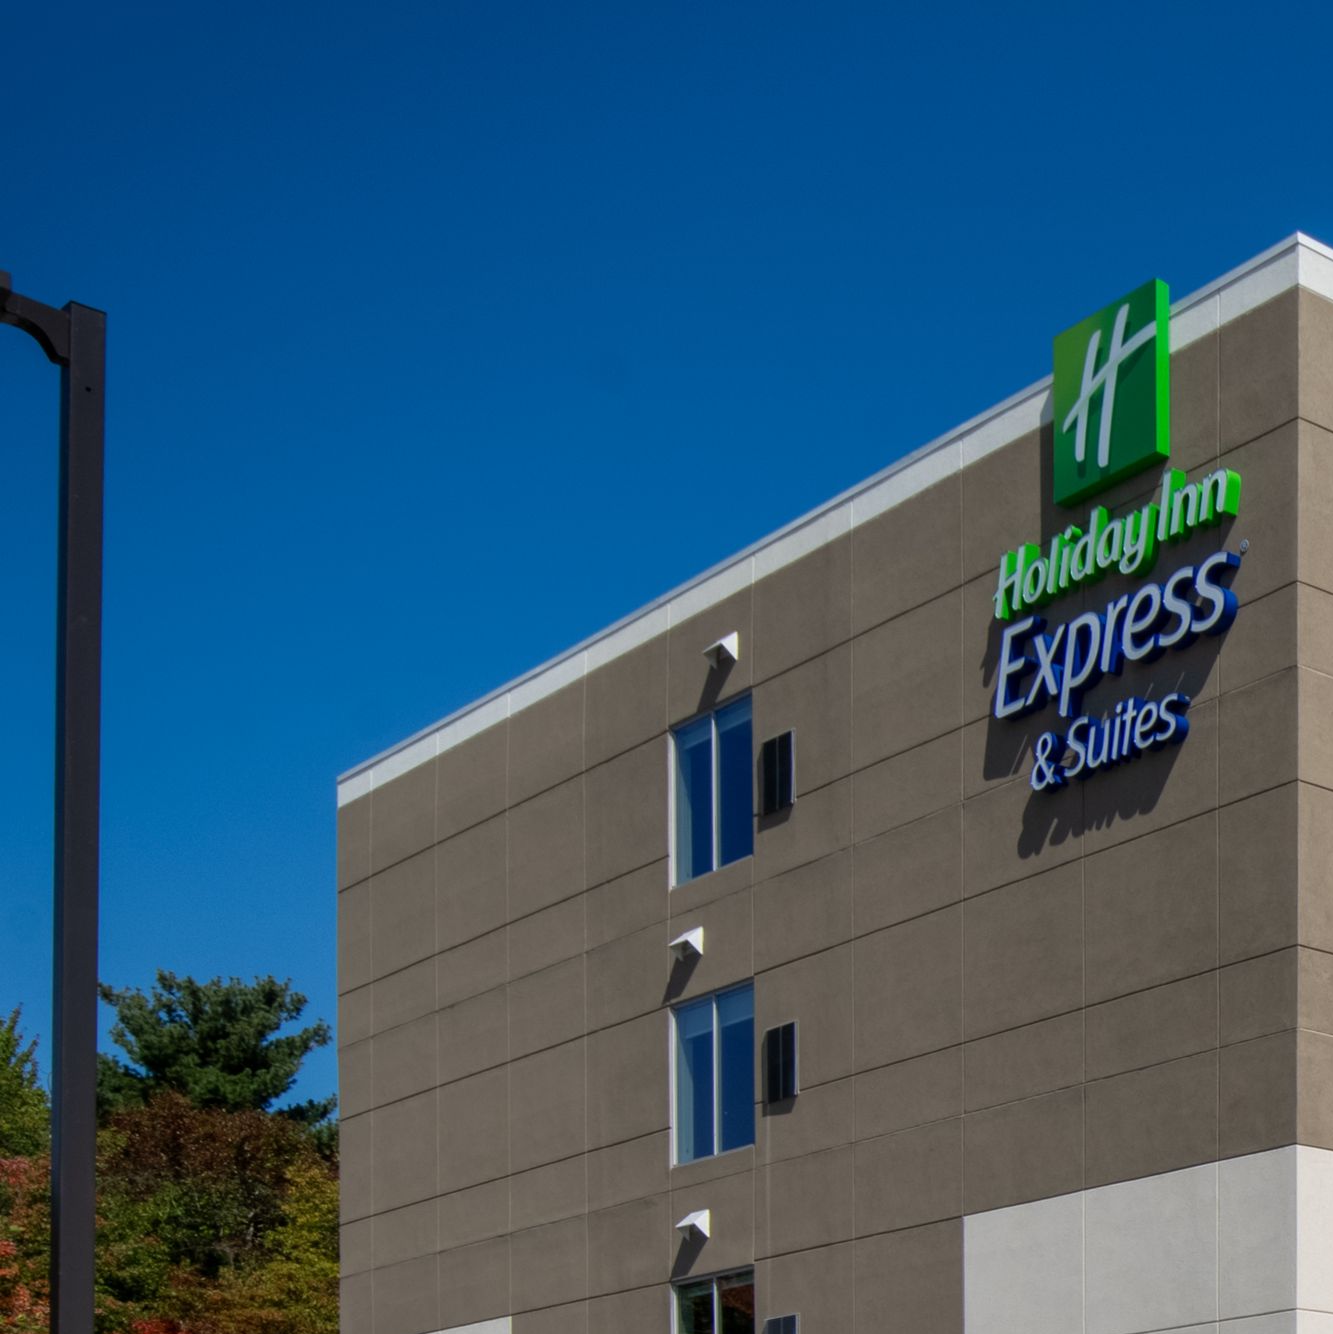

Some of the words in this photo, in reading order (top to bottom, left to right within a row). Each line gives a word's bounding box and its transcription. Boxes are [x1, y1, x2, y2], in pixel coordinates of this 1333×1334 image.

[993, 502, 1158, 620] Holiday
[1157, 468, 1241, 541] Inn
[995, 551, 1240, 718] Express
[1031, 731, 1062, 792] &
[1064, 693, 1190, 778] Suites
